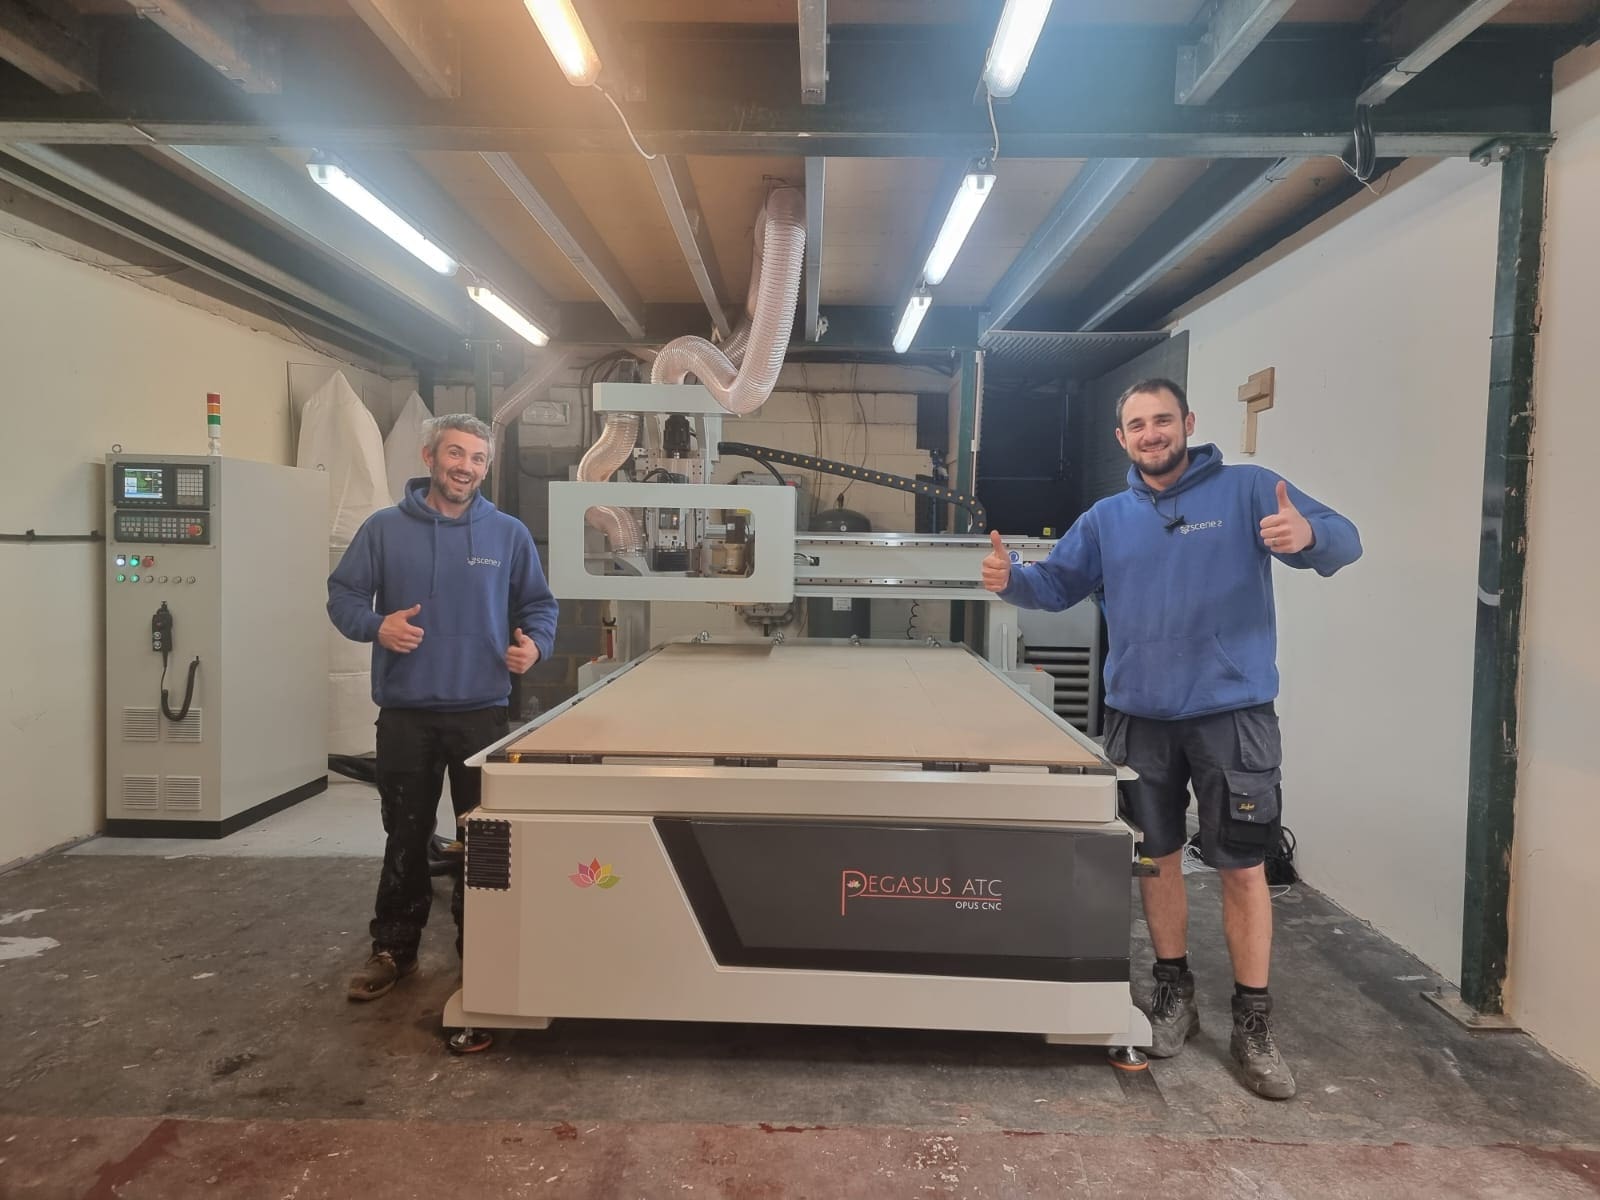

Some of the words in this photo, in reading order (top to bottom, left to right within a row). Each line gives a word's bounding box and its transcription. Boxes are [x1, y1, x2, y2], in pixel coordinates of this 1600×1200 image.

[841, 870, 951, 916] PEGASUS
[961, 878, 1003, 897] ATC
[955, 901, 979, 910] OPUS
[981, 902, 1002, 911] CNC
